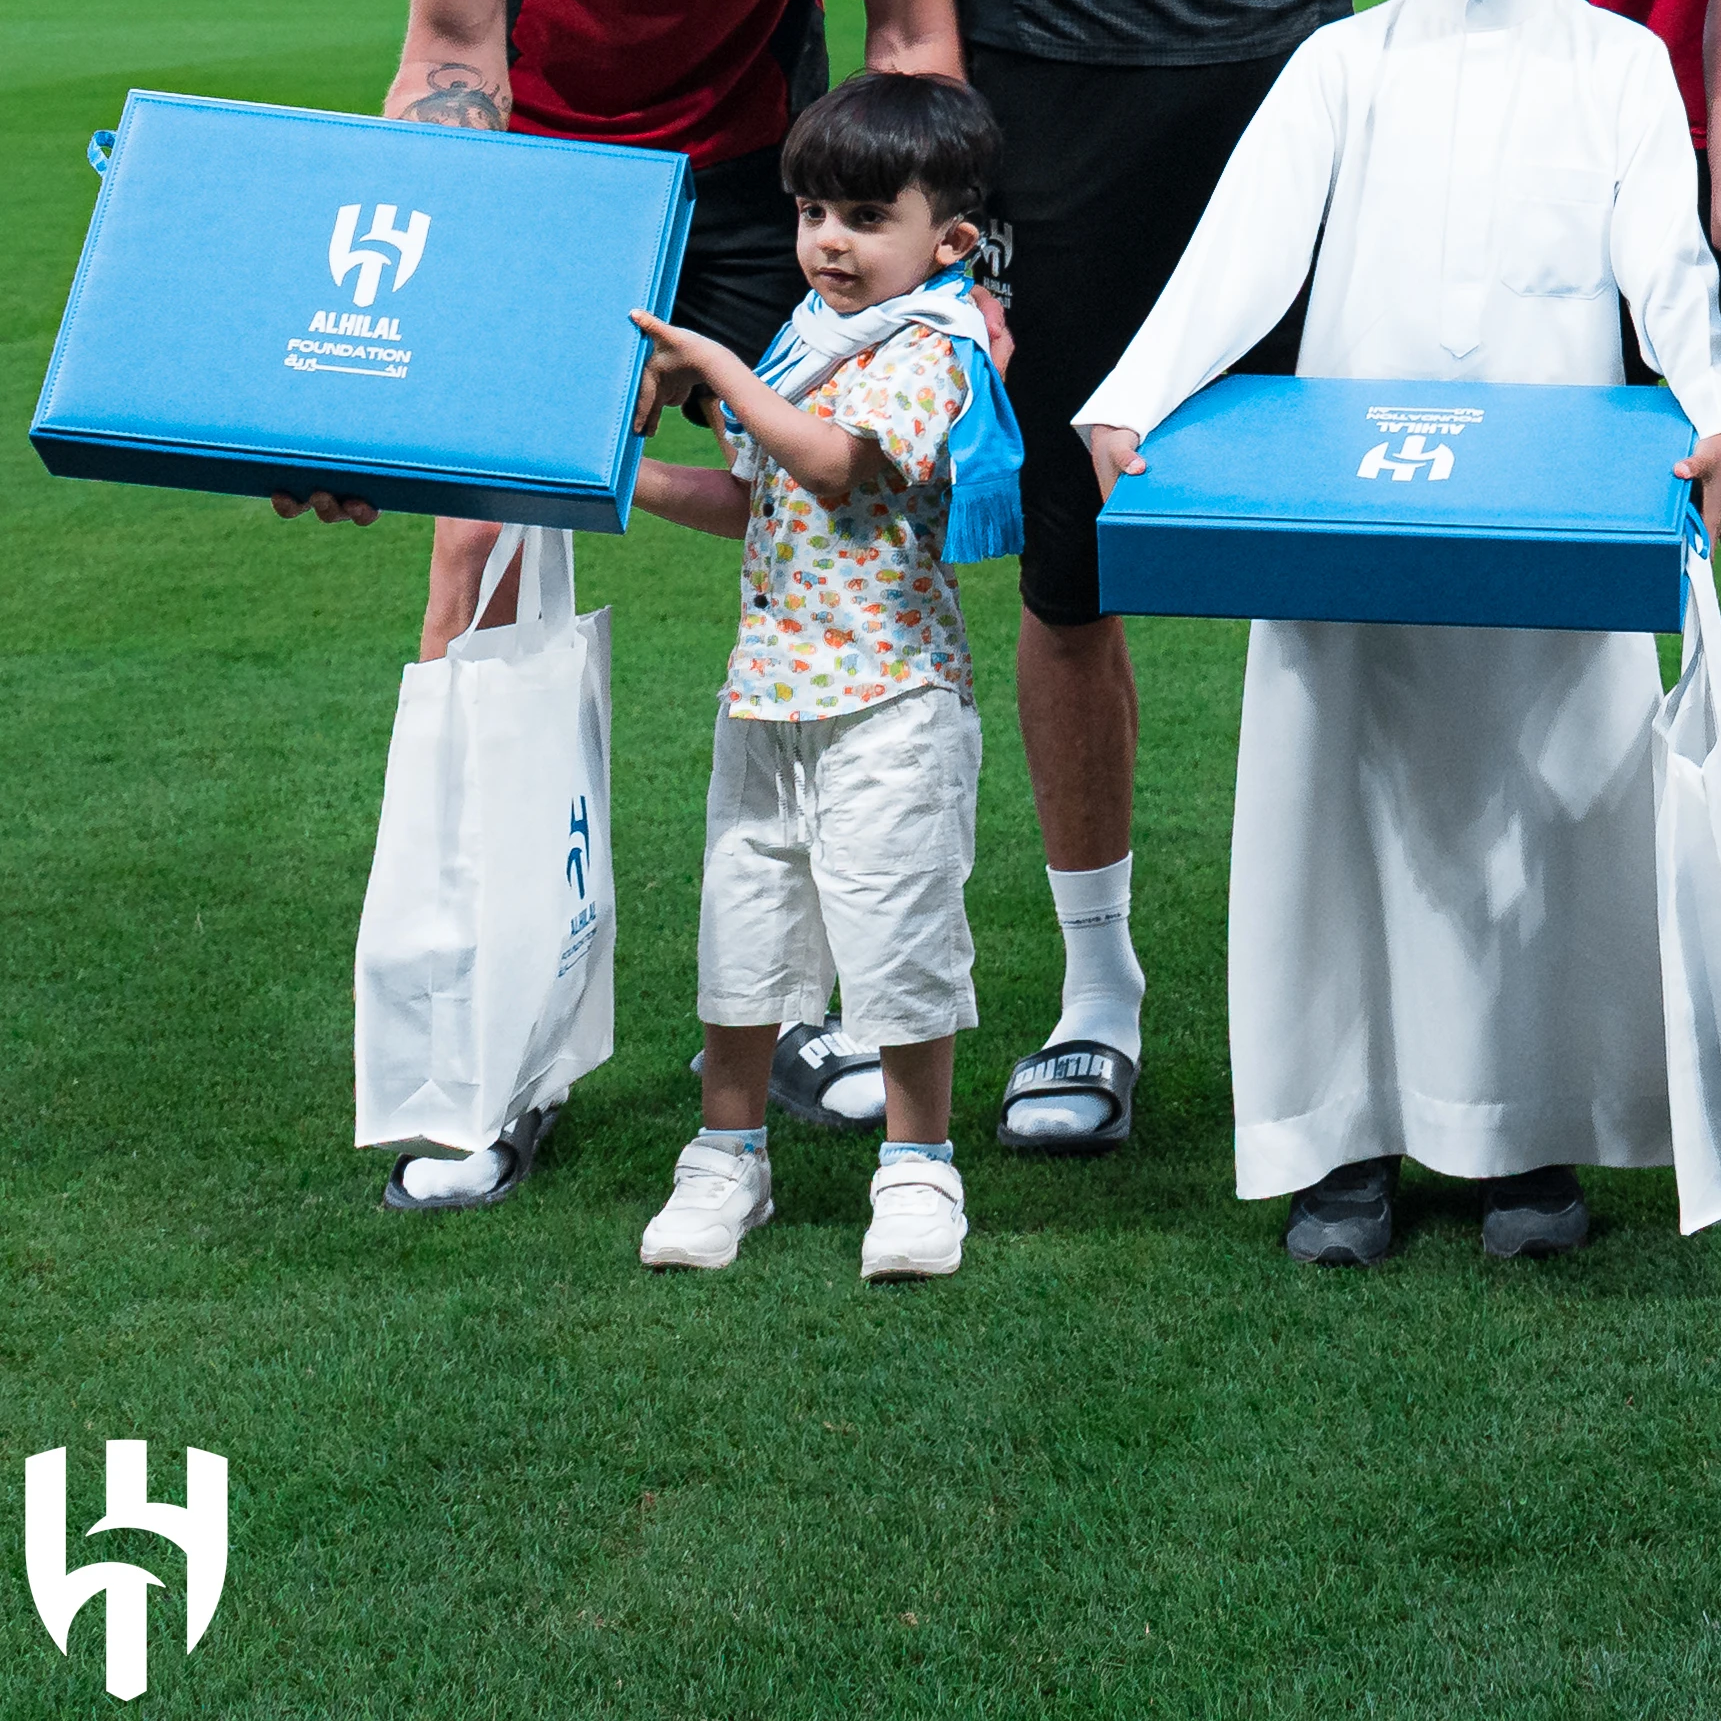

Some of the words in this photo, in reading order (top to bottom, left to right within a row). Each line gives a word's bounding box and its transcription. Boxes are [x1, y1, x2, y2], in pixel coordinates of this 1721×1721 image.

[308, 310, 402, 341] ALHILAL
[286, 338, 412, 364] FOUNDATION
[1376, 421, 1466, 435] ALHILAL
